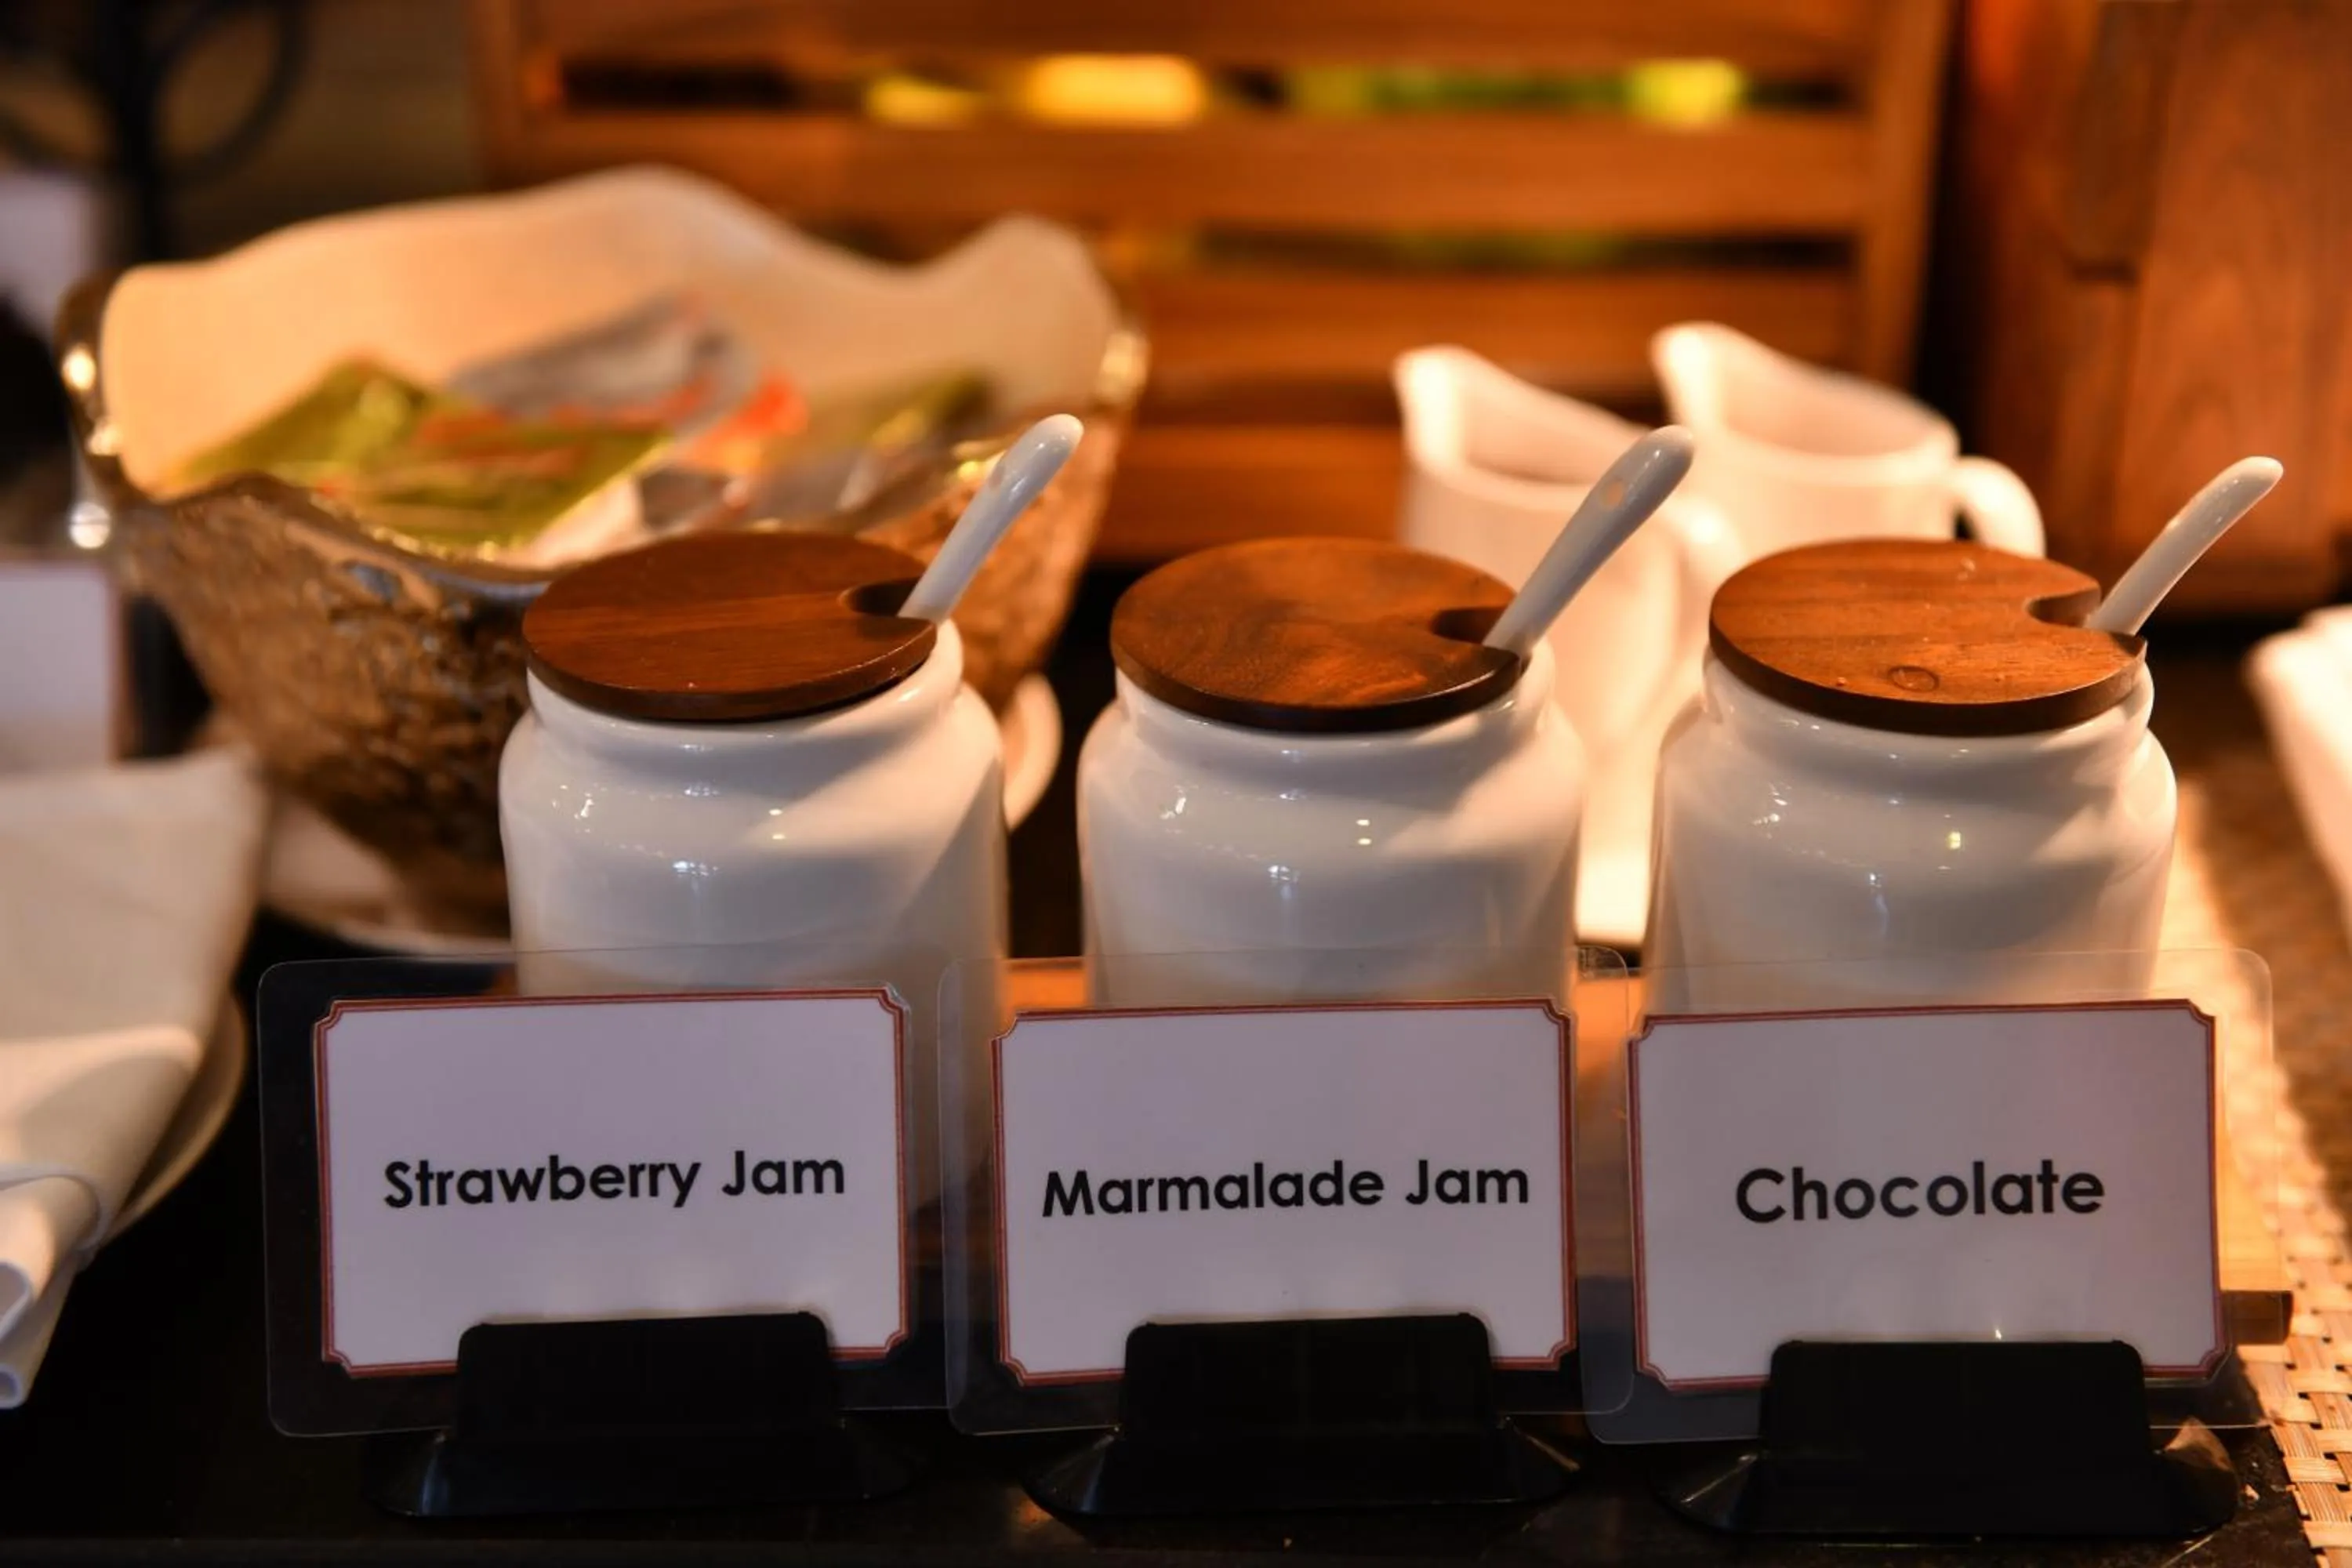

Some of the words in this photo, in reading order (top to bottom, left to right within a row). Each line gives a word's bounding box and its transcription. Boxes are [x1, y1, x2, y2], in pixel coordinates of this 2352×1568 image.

[383, 1153, 702, 1210] Strawberry
[720, 1149, 845, 1197] Jam
[1041, 1159, 1385, 1218] Marmalade
[1404, 1158, 1530, 1206] Jam
[1735, 1158, 2106, 1225] Chocolate
